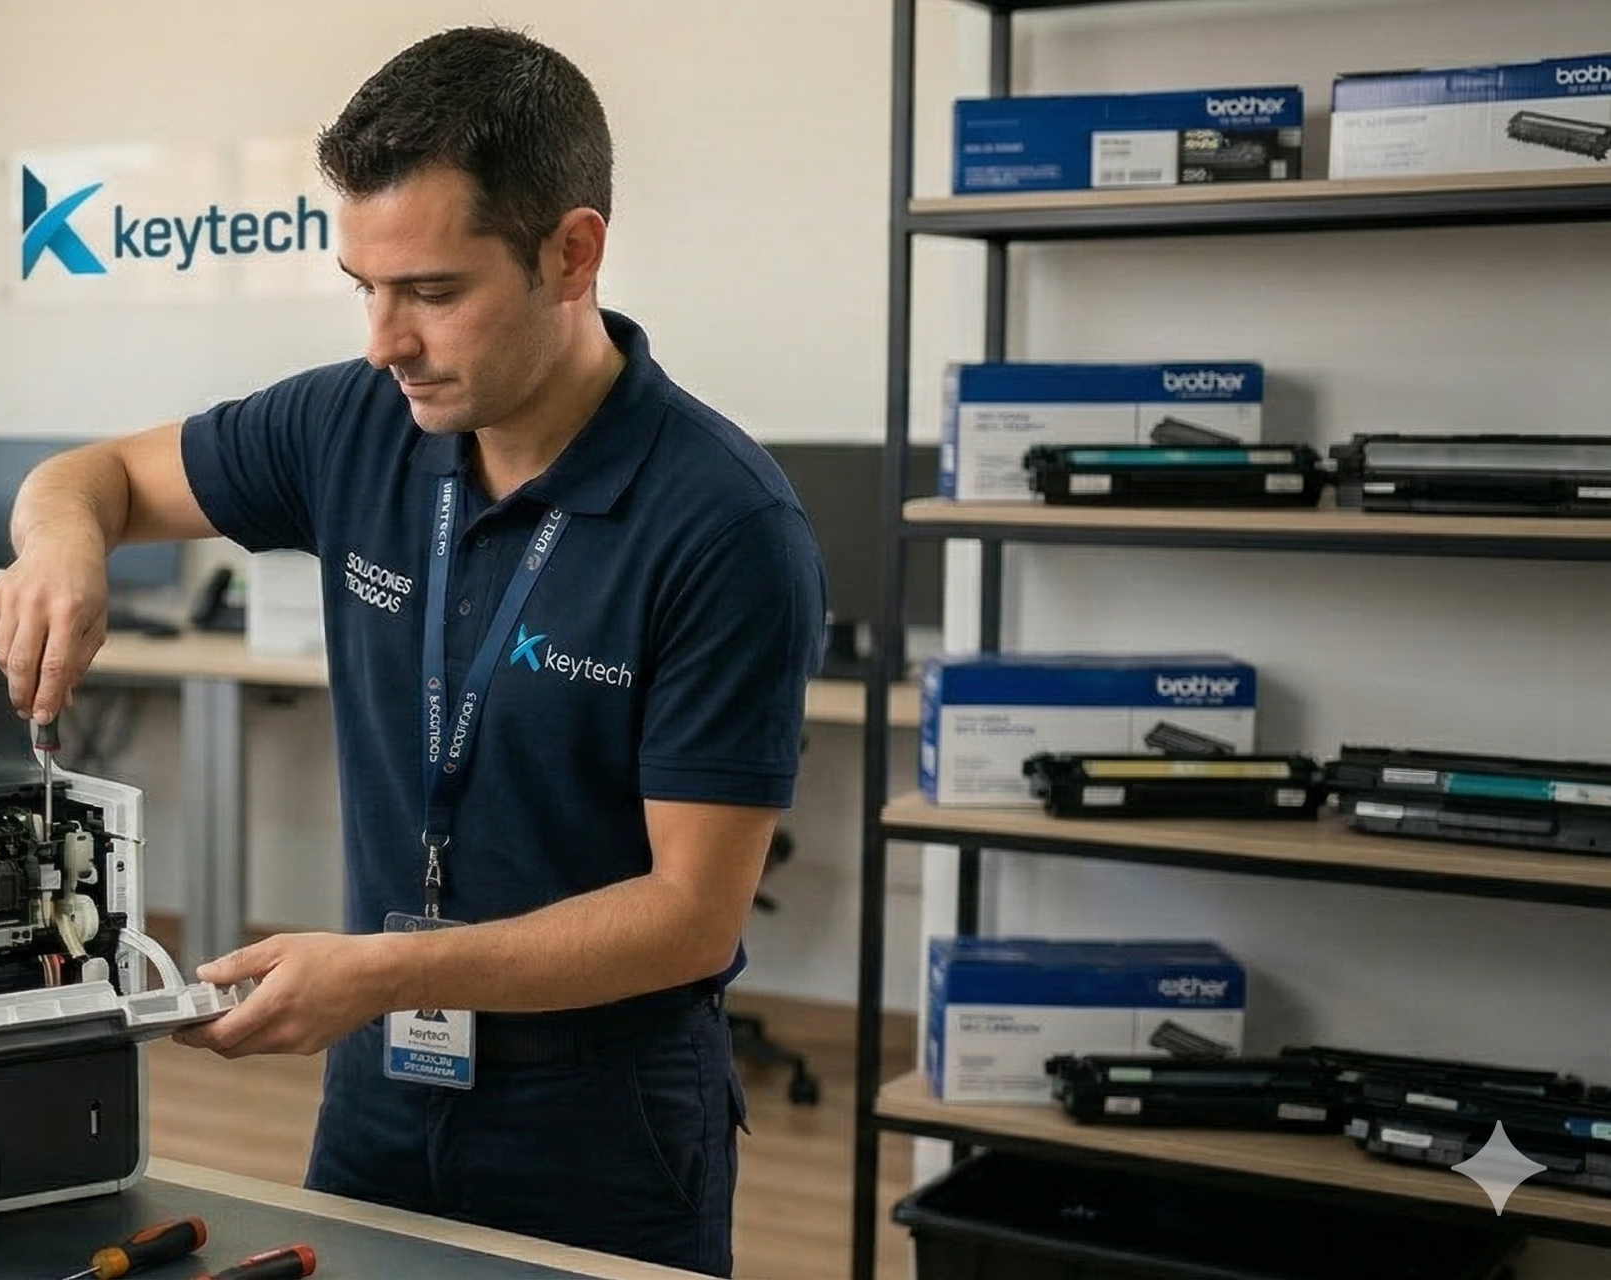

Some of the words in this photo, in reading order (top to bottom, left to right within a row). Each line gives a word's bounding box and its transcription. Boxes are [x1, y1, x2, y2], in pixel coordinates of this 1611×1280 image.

[1555, 64, 1611, 85] broth
[114, 195, 329, 271] keytech
[1162, 370, 1245, 392] brother
[544, 643, 633, 688] keytech
[1156, 675, 1239, 697] brother
